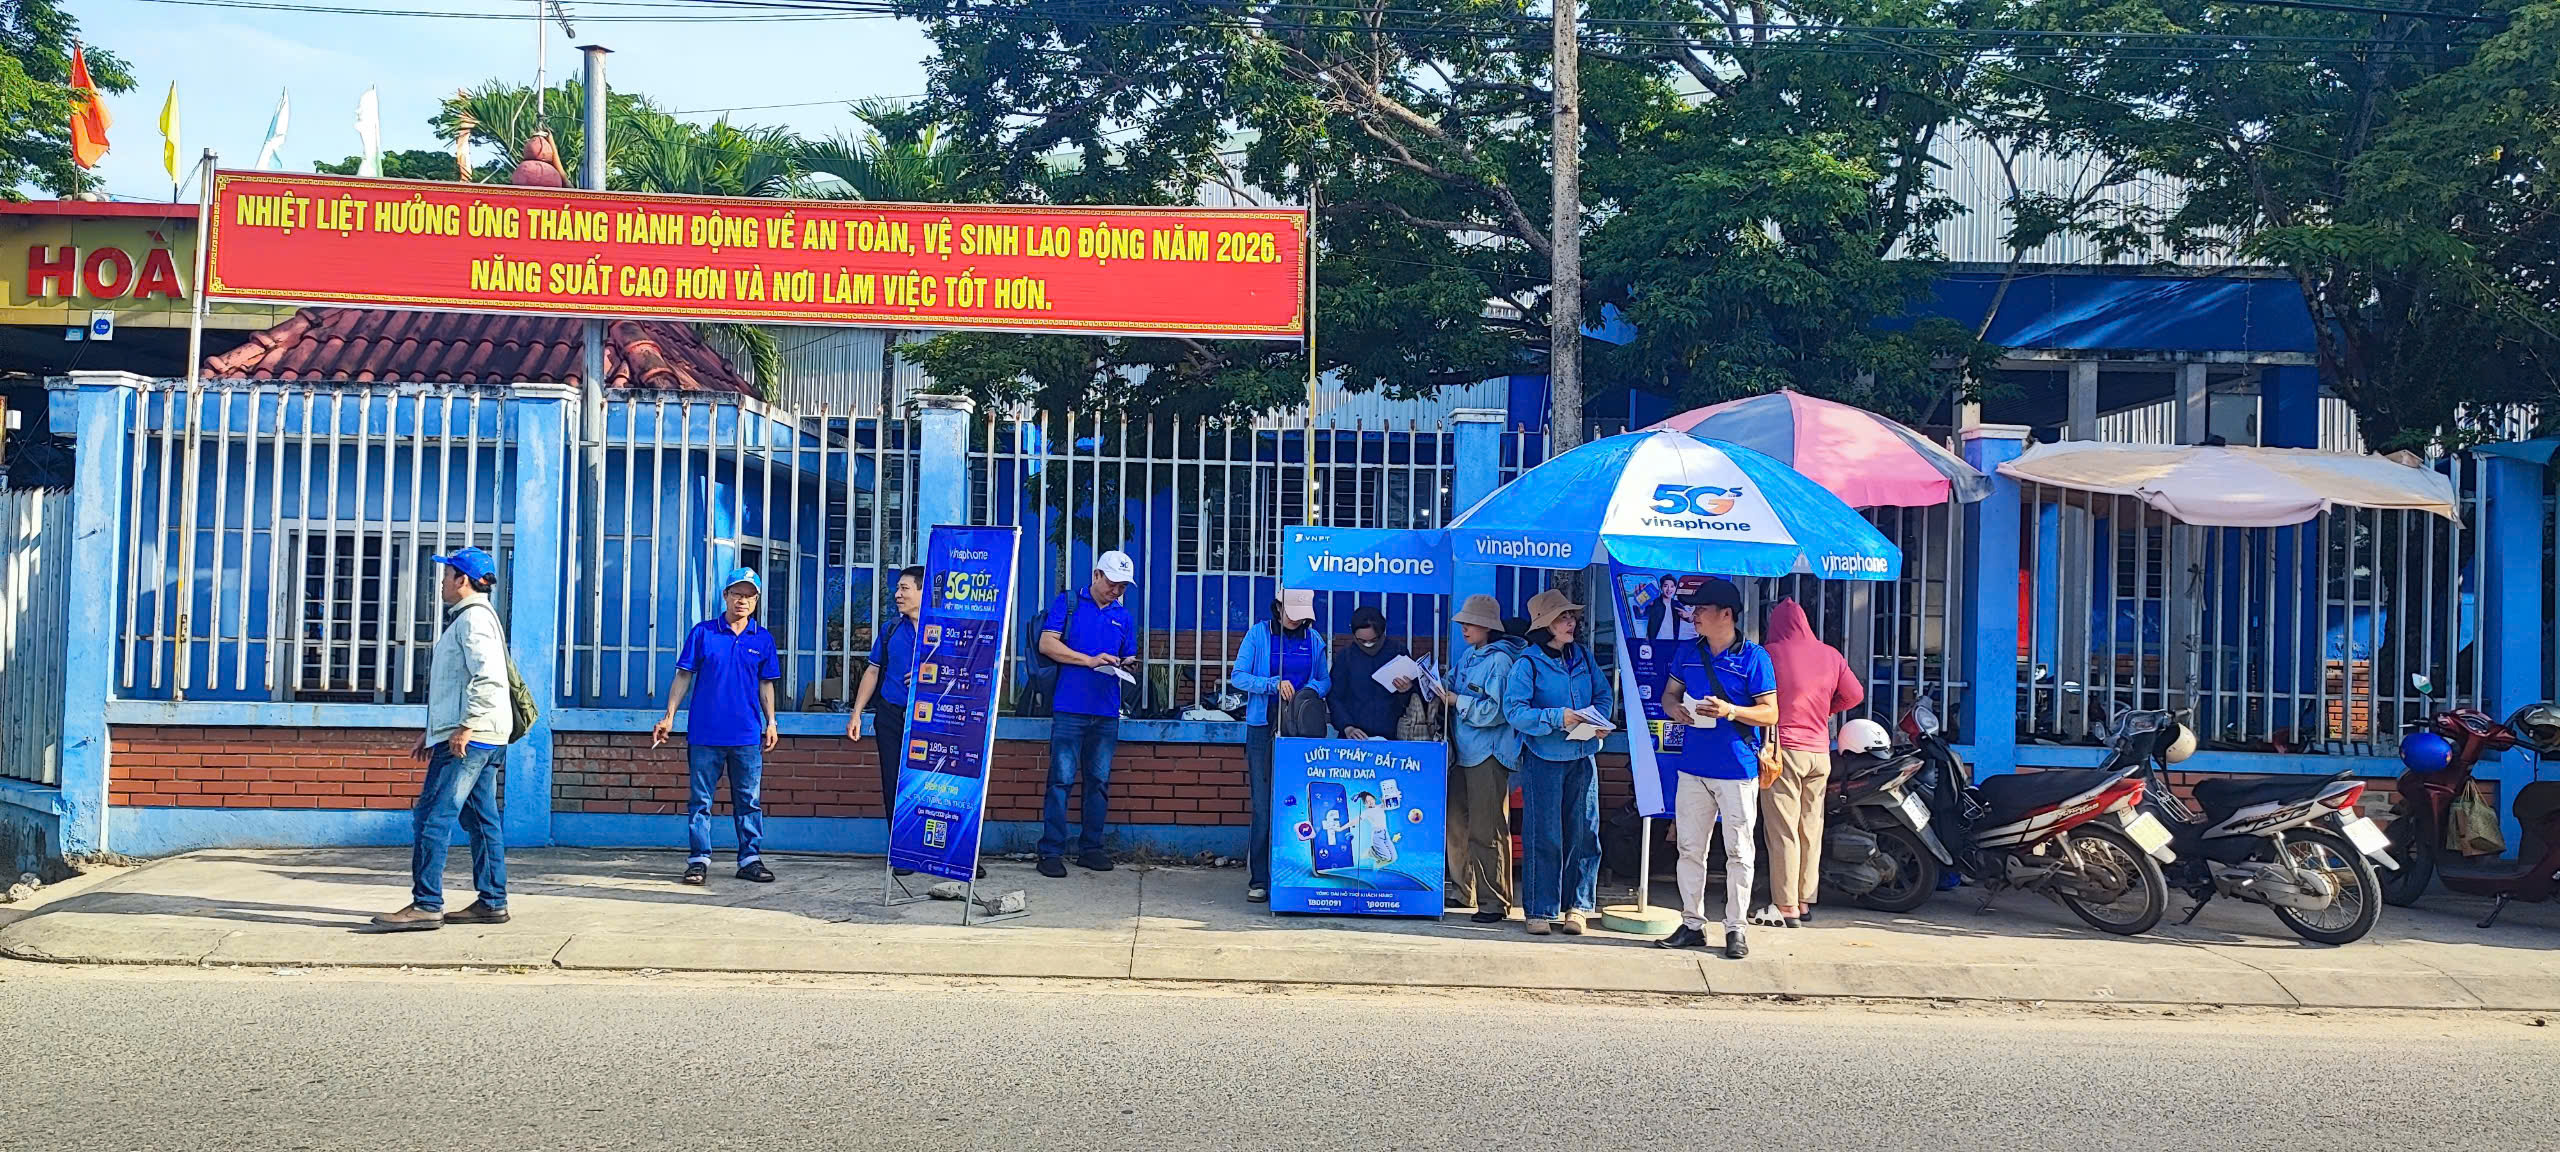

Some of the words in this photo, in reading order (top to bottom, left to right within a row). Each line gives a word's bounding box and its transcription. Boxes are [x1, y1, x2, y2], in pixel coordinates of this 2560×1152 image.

[236, 190, 310, 234] NHIỆT
[316, 194, 368, 238] LIỆT
[374, 193, 460, 236] HƯỞNG
[468, 200, 519, 238] ỨNG
[527, 204, 609, 243] THÁNG
[616, 206, 684, 246] HÀNH
[690, 210, 758, 254] ĐỘNG
[766, 209, 796, 250] VỀ
[802, 219, 838, 251] AN
[845, 216, 915, 258] TOÀN,
[924, 217, 952, 262] VỆ
[960, 223, 1019, 256] SINH
[1026, 226, 1072, 258] LAO
[1078, 222, 1145, 266] ĐỘNG
[1152, 224, 1209, 262] NĂM
[1216, 231, 1282, 264] 2026.
[470, 254, 541, 294] NĂNG
[548, 254, 613, 296] SUẤT
[619, 265, 668, 298] CAO
[674, 265, 727, 301] HƠN
[733, 264, 766, 302] VÀ
[772, 270, 815, 304] NƠI
[822, 267, 875, 306] LÀM
[883, 270, 937, 314] VIỆC
[945, 266, 988, 306] TỐT
[994, 276, 1052, 310] HƠN.
[1640, 516, 1751, 532] vinaphone
[1476, 536, 1572, 558] vinaphone
[1308, 550, 1434, 576] vinaphone
[1821, 550, 1888, 575] vinaphone
[945, 571, 970, 600] 5G
[970, 568, 992, 587] TỐT
[970, 584, 1000, 602] NHẤT
[1354, 769, 1376, 780] DATA
